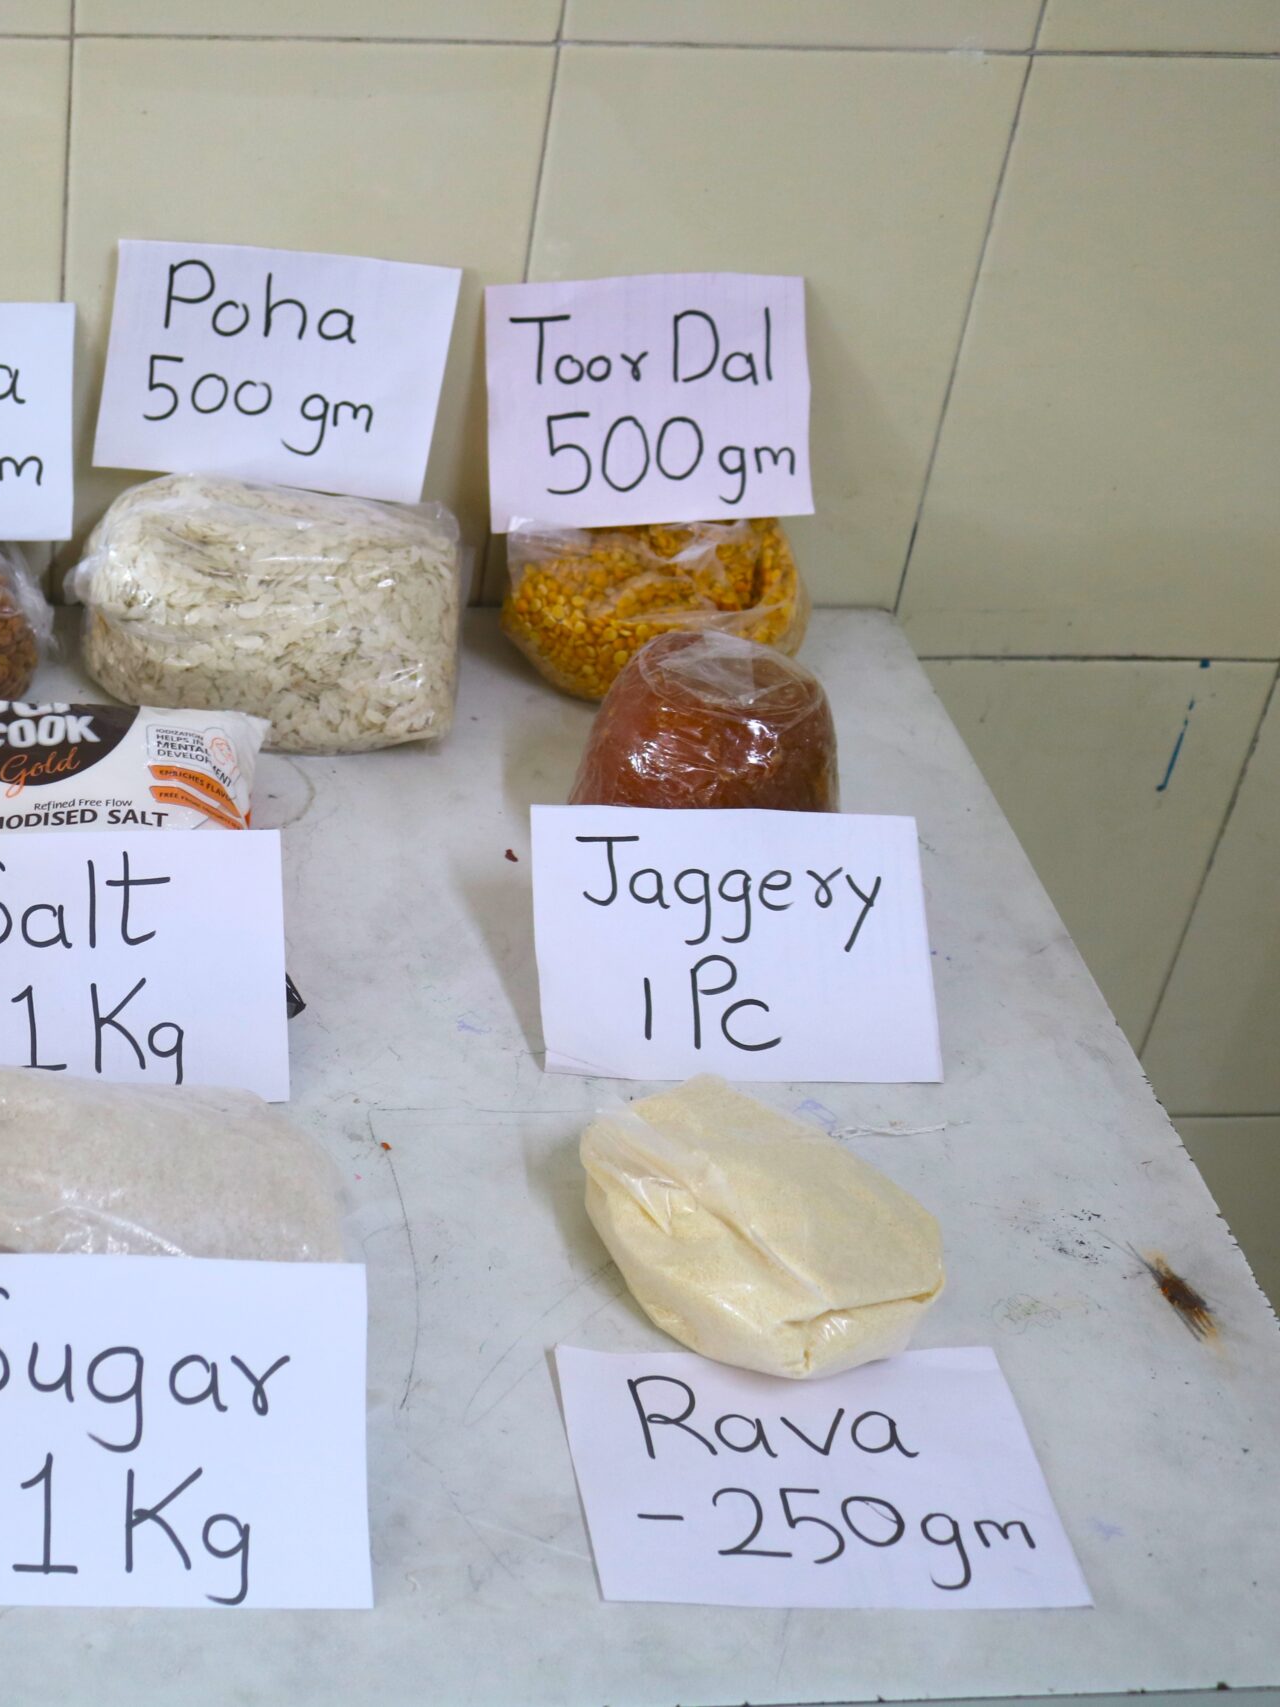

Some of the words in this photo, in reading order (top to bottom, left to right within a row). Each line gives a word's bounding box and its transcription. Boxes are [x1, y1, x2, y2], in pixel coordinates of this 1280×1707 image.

[163, 258, 357, 345] Poha
[508, 313, 649, 386] Toor
[672, 306, 774, 387] Dal
[142, 353, 273, 422] 500
[283, 392, 374, 457] gm
[0, 746, 80, 798] Gold
[156, 734, 189, 744] HELPS
[193, 738, 205, 747] IN
[157, 741, 211, 756] MENTAL
[159, 769, 205, 787] ENRICHES
[34, 799, 75, 811] Refined
[78, 798, 102, 807] Free
[105, 799, 132, 807] Flow
[107, 809, 168, 827] SALT
[574, 834, 883, 954] Jaggery
[689, 947, 782, 1053] Pc
[626, 1374, 920, 1462] Rava
[11, 1452, 79, 1575] 1
[124, 1465, 251, 1607] Kg
